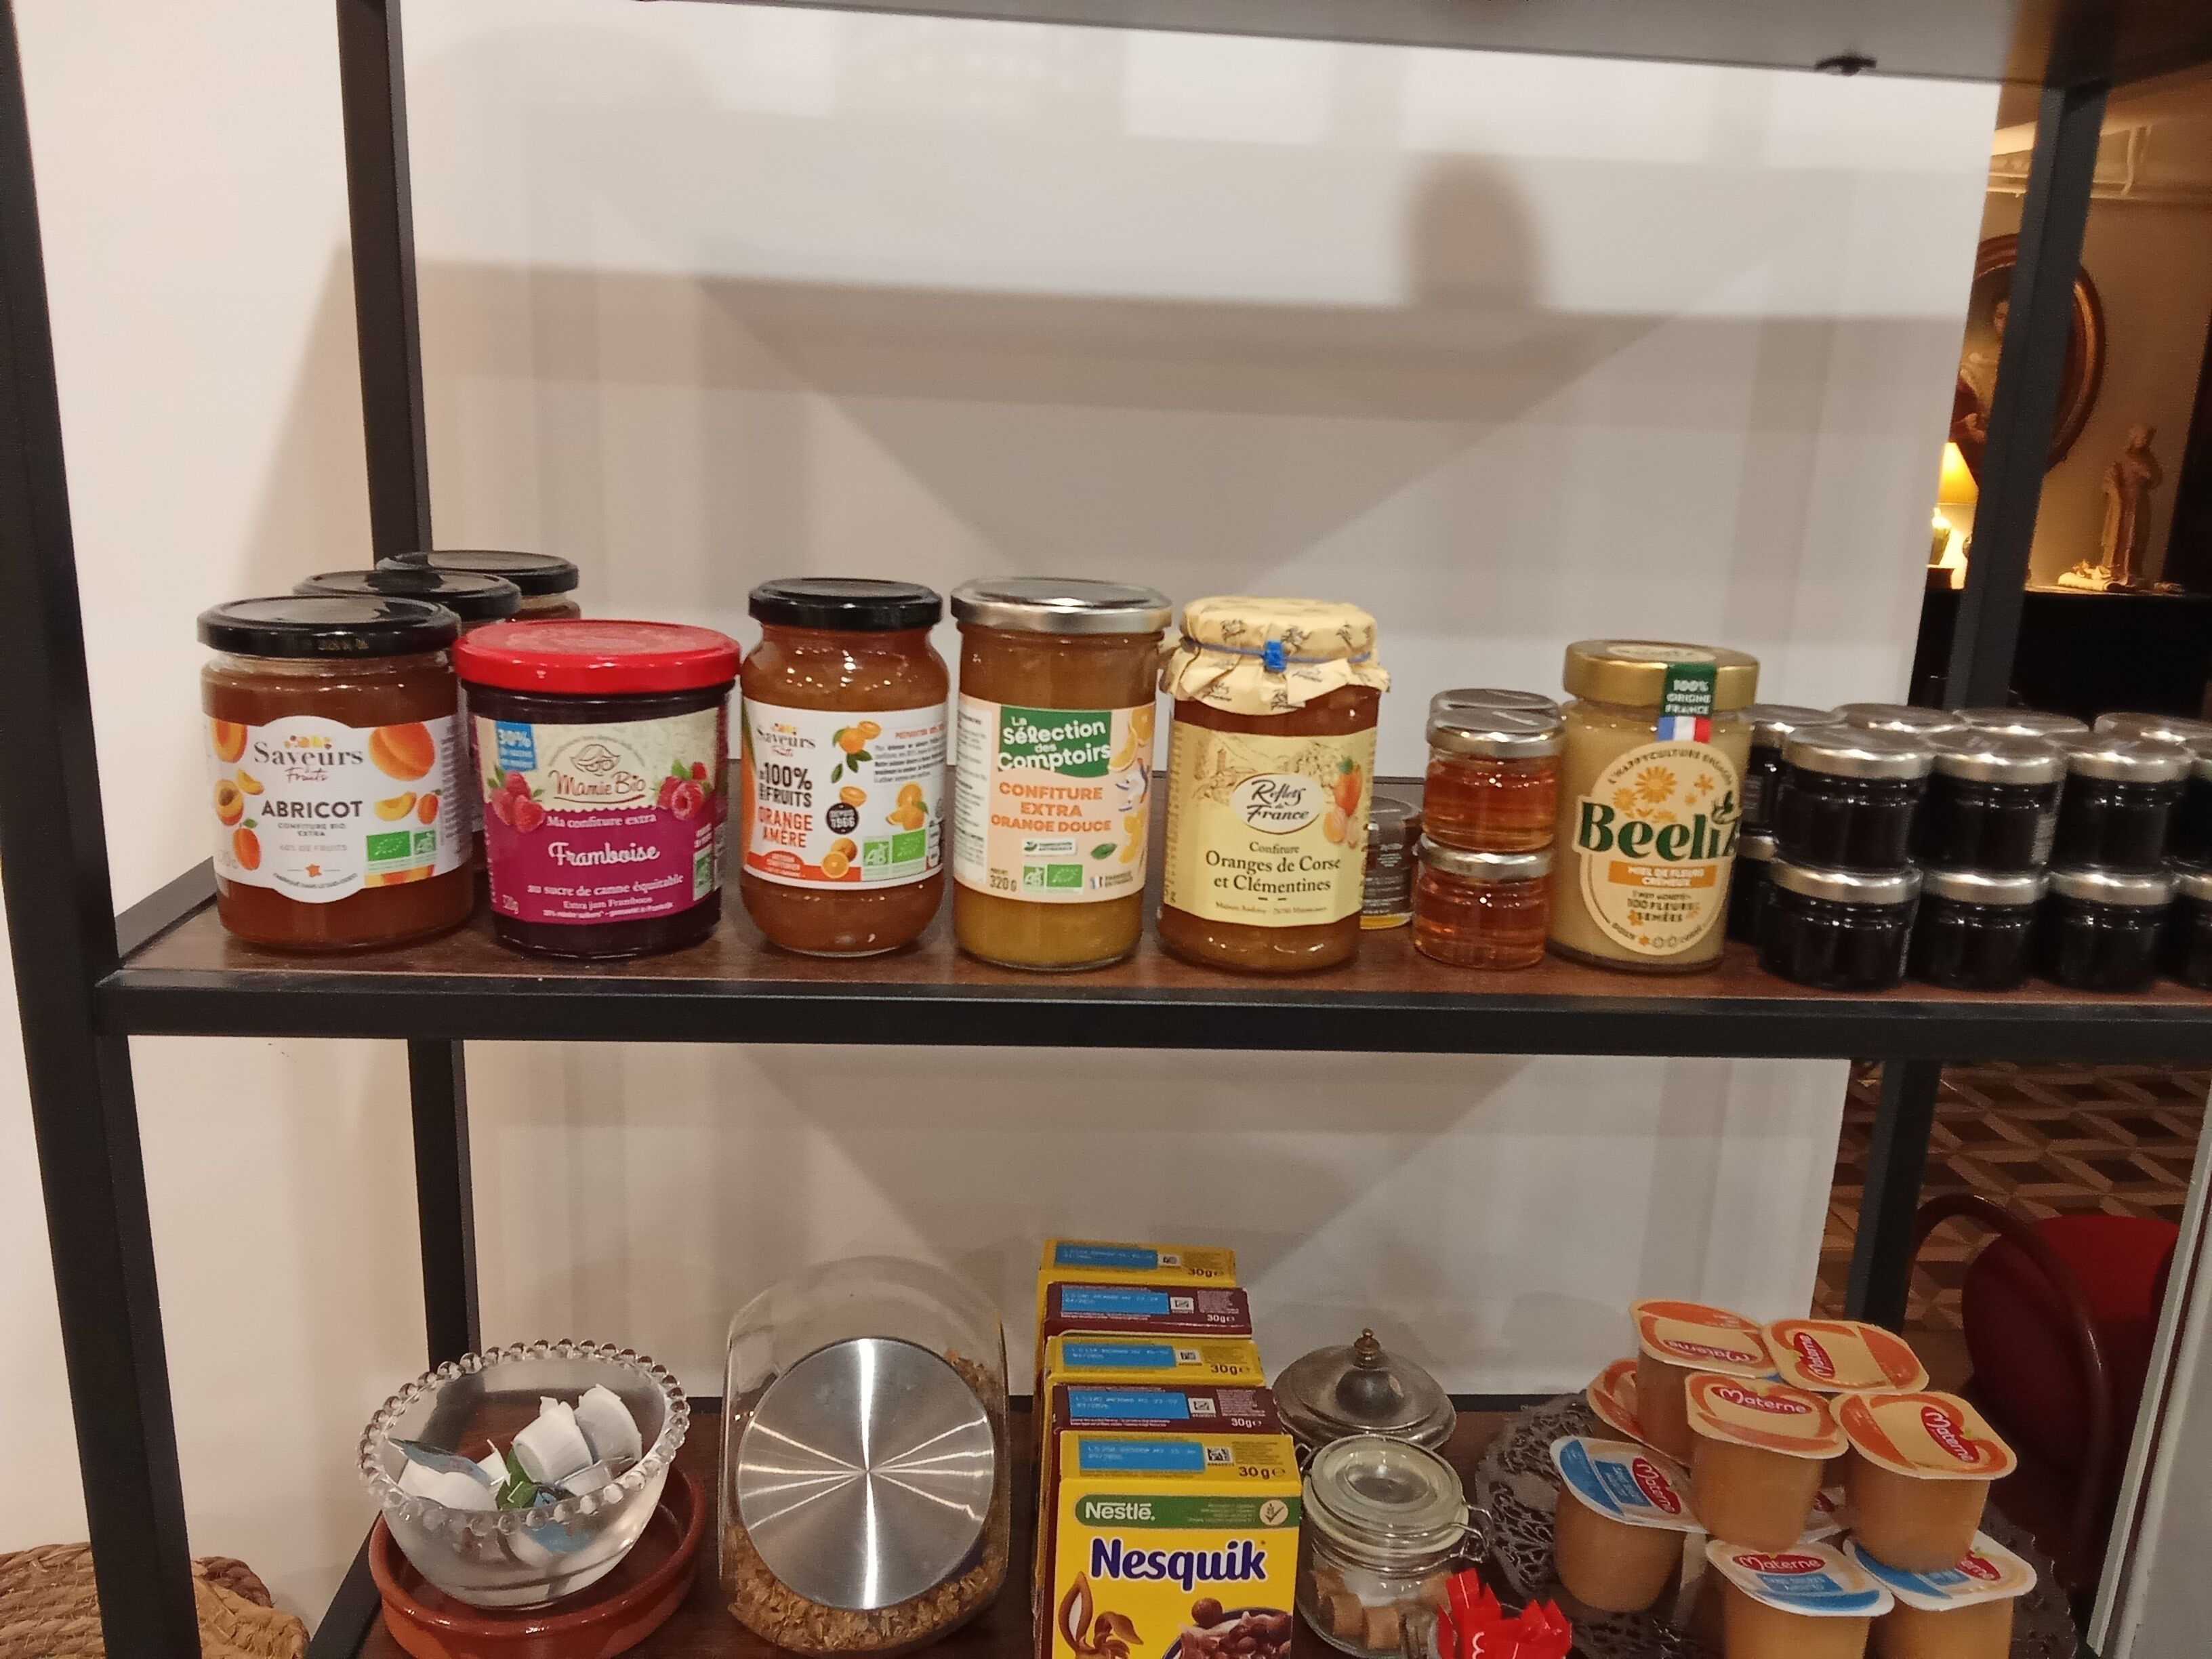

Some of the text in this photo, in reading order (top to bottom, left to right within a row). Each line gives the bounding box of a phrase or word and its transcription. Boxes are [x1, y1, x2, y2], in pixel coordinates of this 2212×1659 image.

[1673, 679, 1708, 692] 100%
[1665, 703, 1709, 715] FRANCE
[1666, 693, 1711, 703] ORIGINE
[1011, 716, 1027, 726] La
[756, 724, 816, 749] Saveurs
[1003, 720, 1106, 745] Sélection
[253, 741, 364, 765] Saveurs
[998, 743, 1111, 771] Comptoirs
[1034, 743, 1057, 753] des
[548, 770, 647, 796] Mamie Bio
[764, 762, 813, 790] 100%
[766, 786, 812, 808] FRUITS
[998, 781, 1103, 800] CONFITURE
[1251, 779, 1307, 806] Reflets
[262, 800, 363, 819] ABRICOT
[1021, 802, 1083, 817] EXTRA
[1246, 804, 1309, 823] France
[546, 814, 657, 828] Ma confiture extra
[991, 815, 1112, 832] ORANGE DOUCE
[548, 842, 661, 867] Framboise
[1249, 841, 1300, 854] Confiture
[1205, 850, 1341, 875] Oranges de Corse
[527, 874, 684, 897] au sucre de canne équitable
[1214, 874, 1332, 894] et Clémentines
[1719, 1388, 1807, 1414] Materne
[1924, 1412, 1975, 1463] Materne
[1636, 1463, 1675, 1513] Materne
[1090, 1538, 1267, 1592] Nesquik
[1738, 1557, 1819, 1571] Materne
